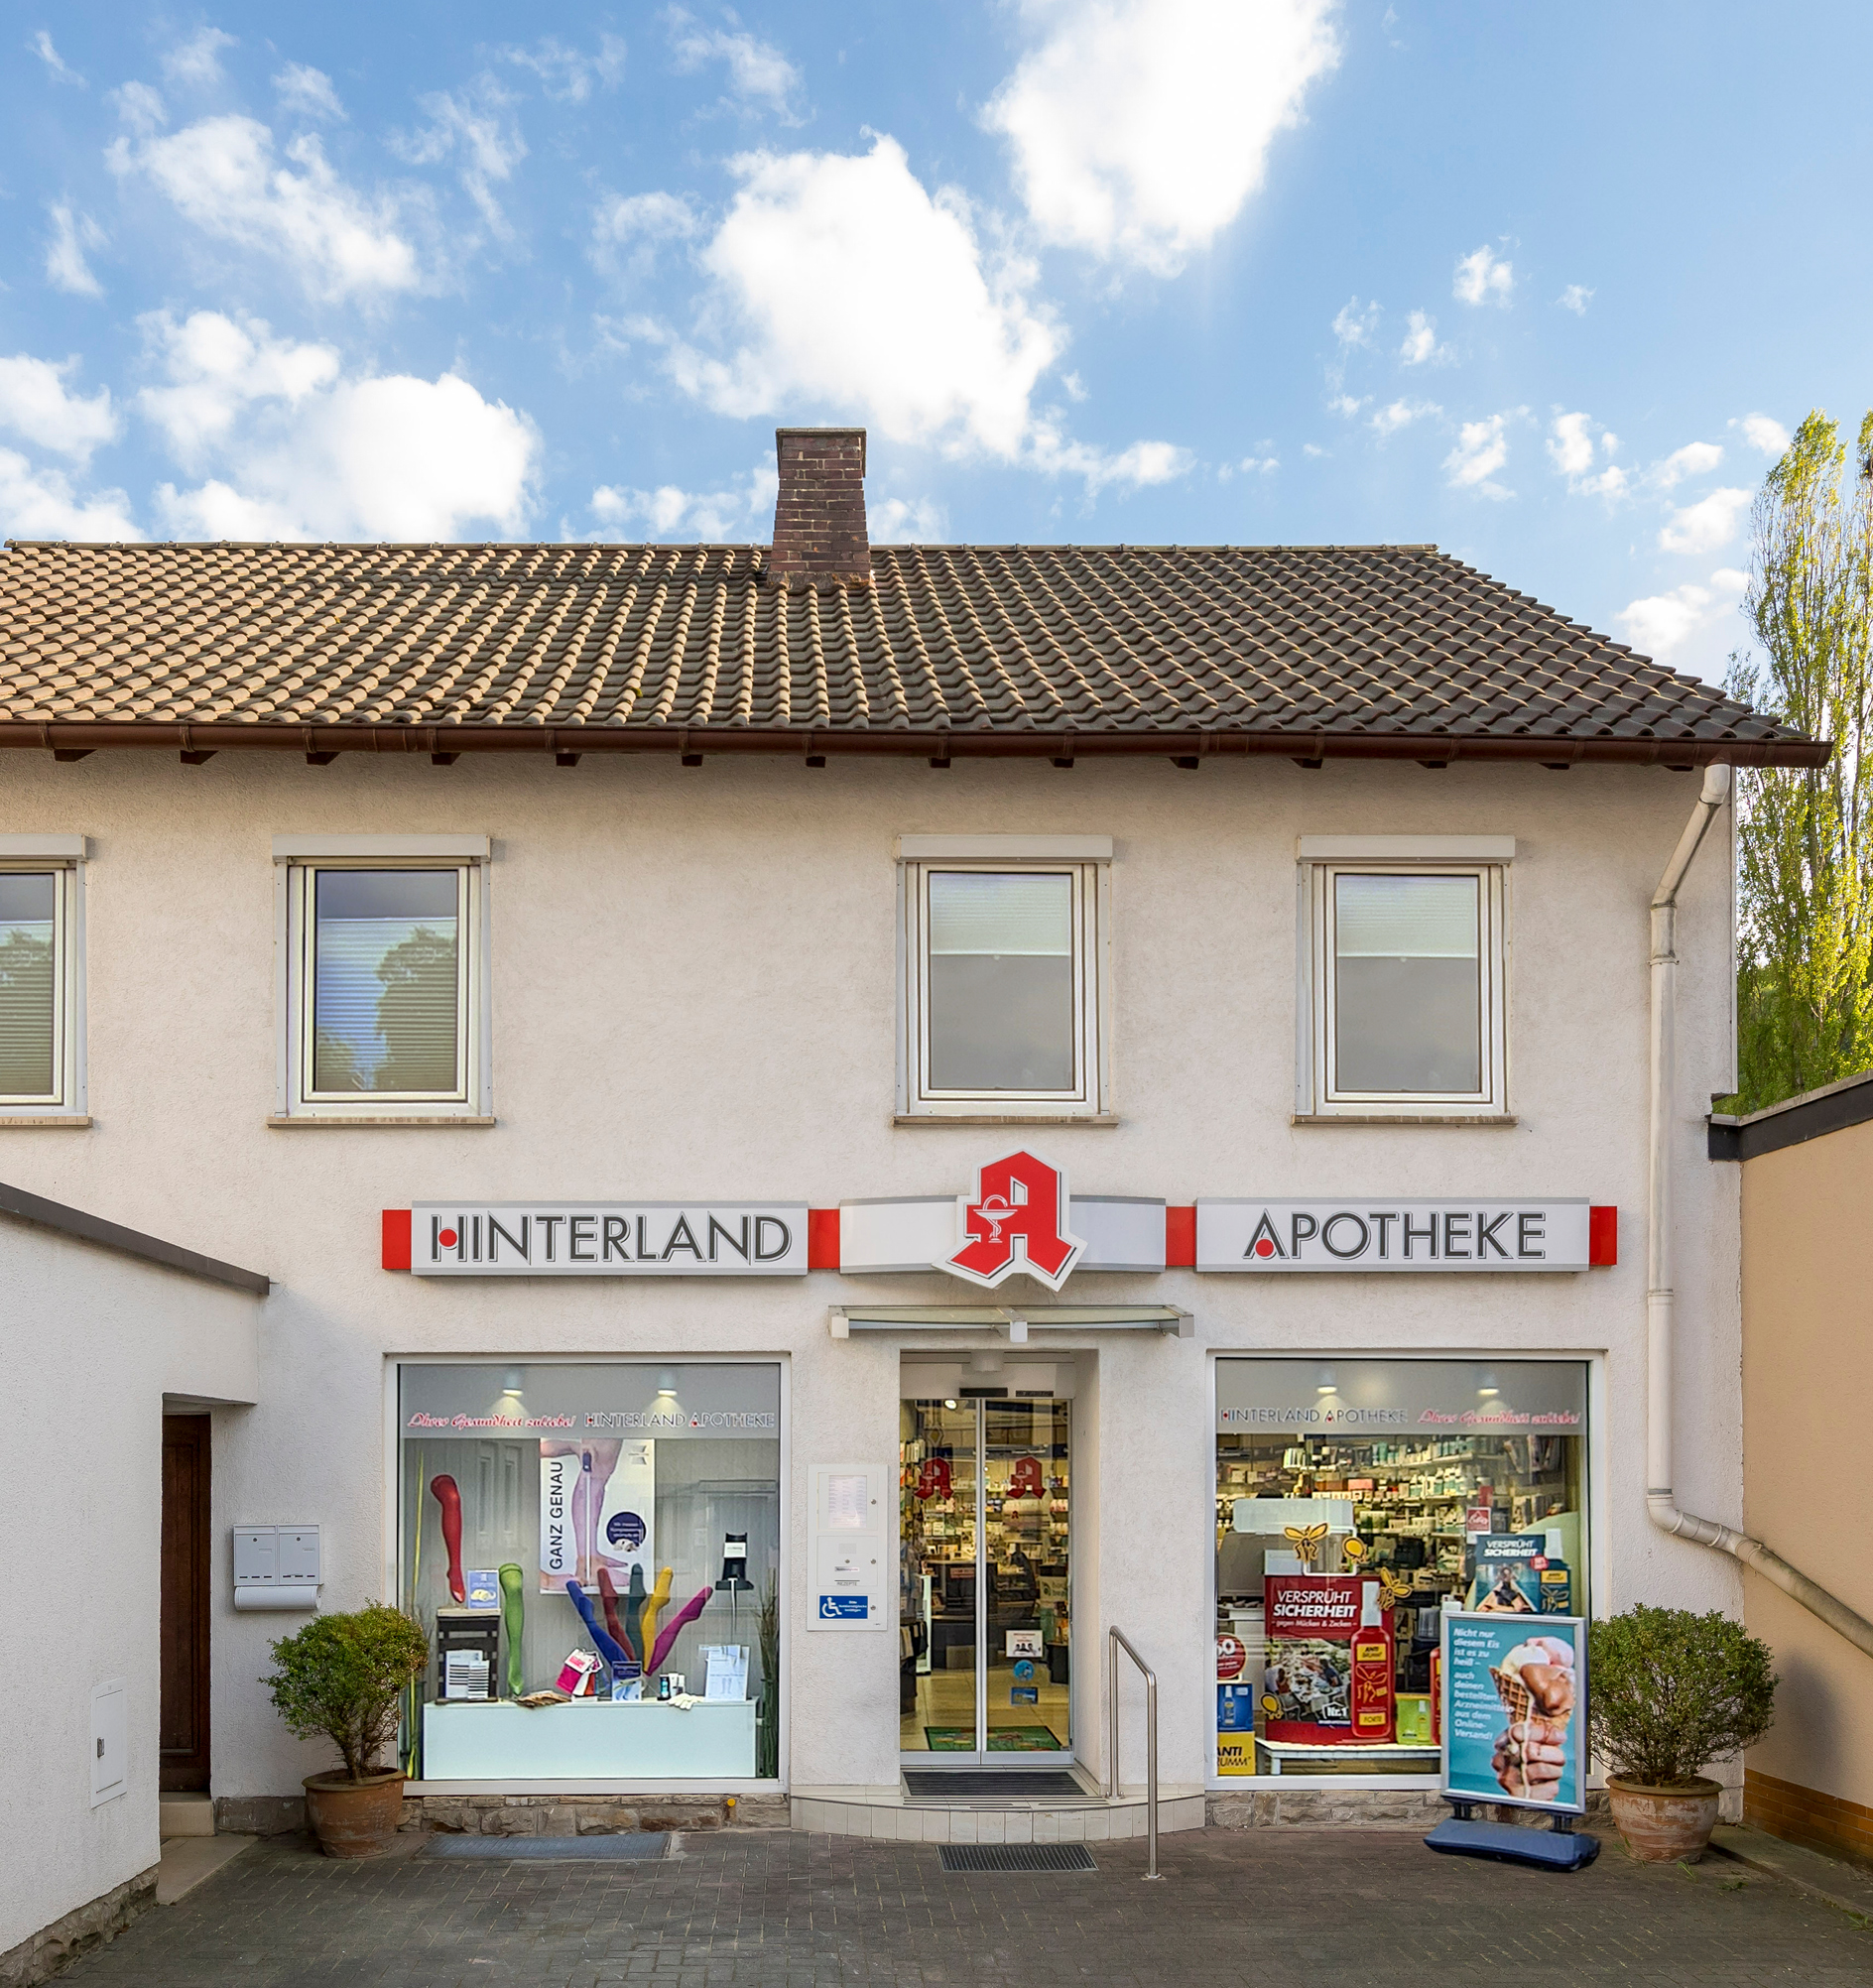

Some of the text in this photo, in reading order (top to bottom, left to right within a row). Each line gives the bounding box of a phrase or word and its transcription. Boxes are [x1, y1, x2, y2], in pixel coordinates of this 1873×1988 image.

[431, 1211, 793, 1266] HINTERLAND
[1242, 1208, 1546, 1260] APOTHEKE
[584, 1412, 775, 1428] HINTERLAND APOTHEKE
[1220, 1408, 1407, 1424] HINTERLAND APOTHEKE
[450, 1413, 523, 1430] Gesundheit
[550, 1461, 562, 1569] GANZ GENAU
[1486, 1539, 1535, 1549] VERSPRÜHT
[1483, 1549, 1538, 1557] SICHERHEIT
[1277, 1588, 1353, 1604] VERSPRÜHT
[1273, 1604, 1357, 1618] SICHERHEIT
[1453, 1628, 1478, 1637] Nicht
[1453, 1638, 1485, 1647] diesem
[1453, 1647, 1465, 1656] ist
[1453, 1657, 1474, 1667] heiß
[1453, 1680, 1484, 1690] deinen
[1453, 1689, 1498, 1700] bestellten
[1471, 1710, 1491, 1720] dem
[1454, 1719, 1486, 1729] Online-
